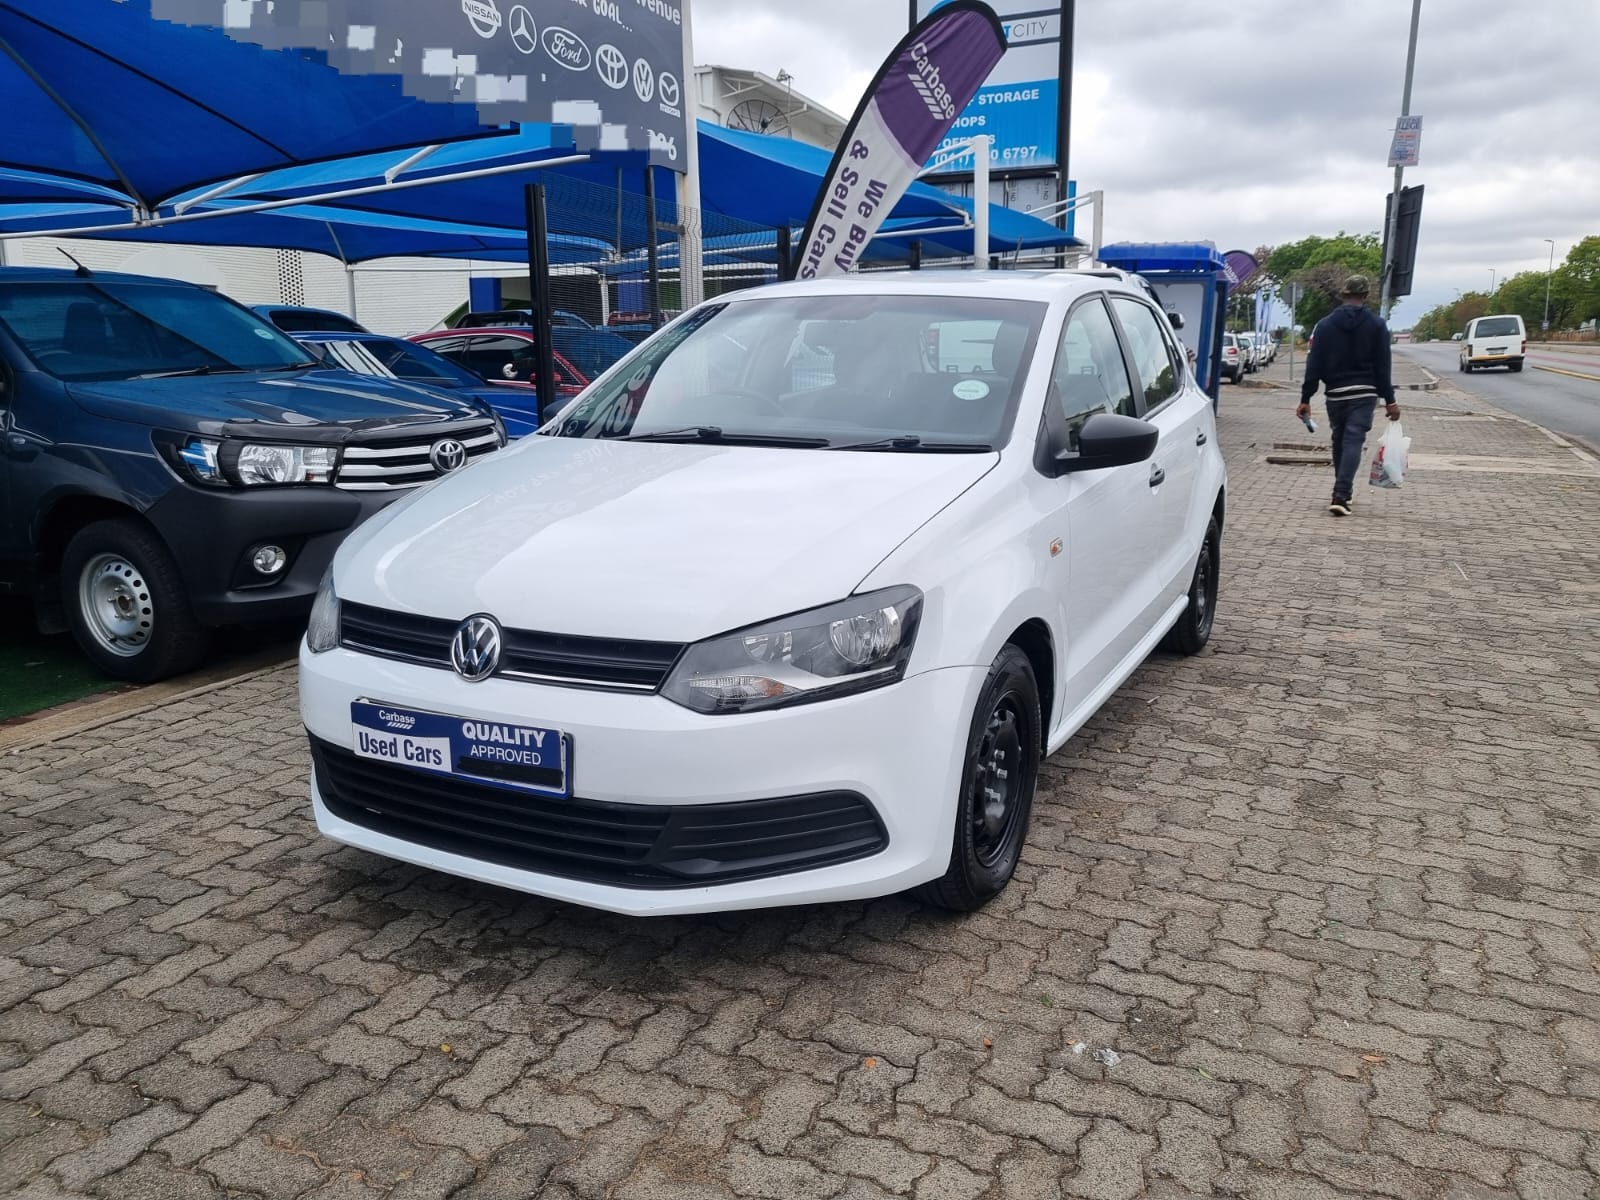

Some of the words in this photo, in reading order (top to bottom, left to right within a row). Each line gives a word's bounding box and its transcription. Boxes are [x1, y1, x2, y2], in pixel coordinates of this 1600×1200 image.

[464, 1, 500, 24] NISSAN
[551, 32, 582, 64] Ford
[910, 42, 955, 119] Carbase
[978, 89, 1040, 105] STORAGE
[849, 139, 869, 160] &
[1003, 146, 1038, 160] 6797
[827, 166, 860, 220] Sell
[857, 179, 888, 219] We
[801, 223, 836, 279] Cars
[834, 223, 867, 273] Buy
[378, 709, 416, 725] Carbase
[359, 731, 399, 759] Used
[403, 738, 443, 766] Cars
[462, 721, 546, 748] QUALITY
[470, 744, 542, 766] APPROVED
